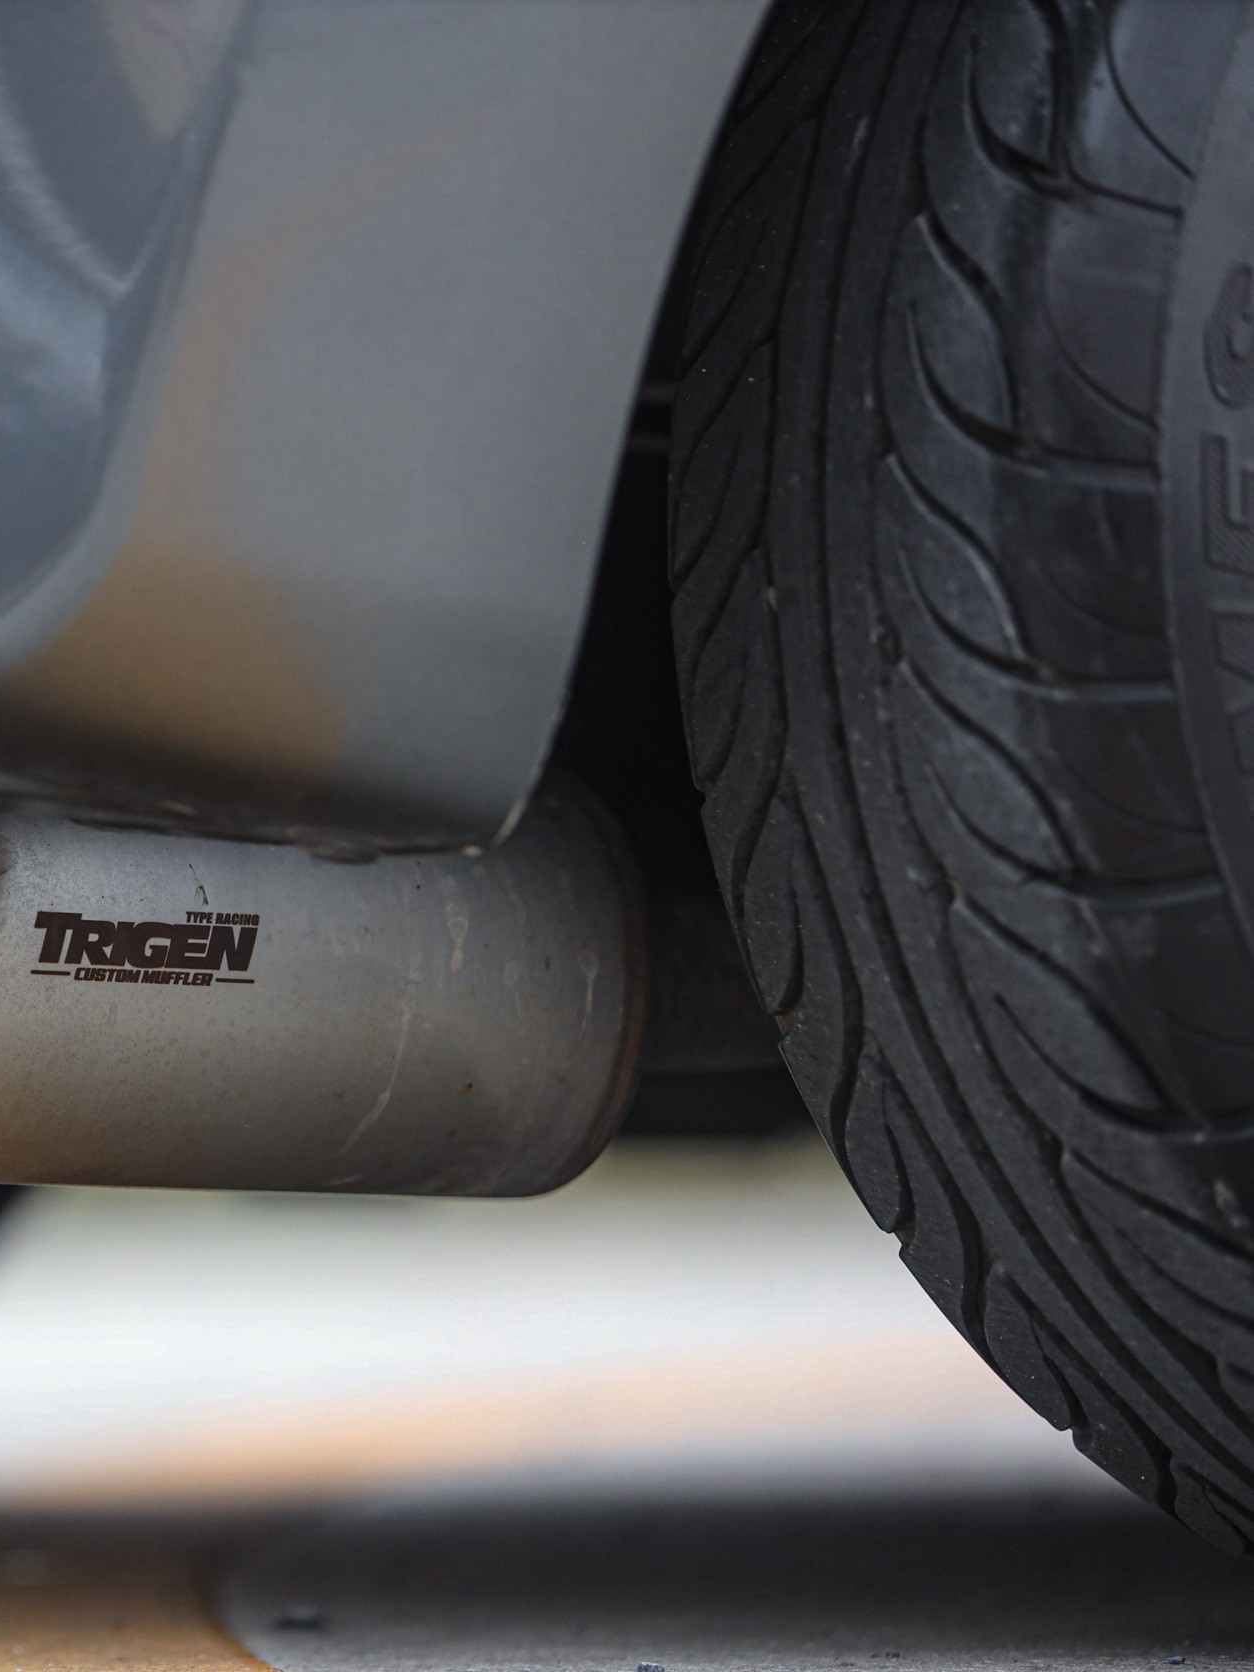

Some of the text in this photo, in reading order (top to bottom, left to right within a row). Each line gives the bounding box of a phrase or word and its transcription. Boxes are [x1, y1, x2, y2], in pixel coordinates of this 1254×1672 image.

[185, 911, 260, 926] TYPE RACING
[34, 911, 258, 972] TRIGEN
[74, 967, 214, 986] CUSTOM MUFFLER
